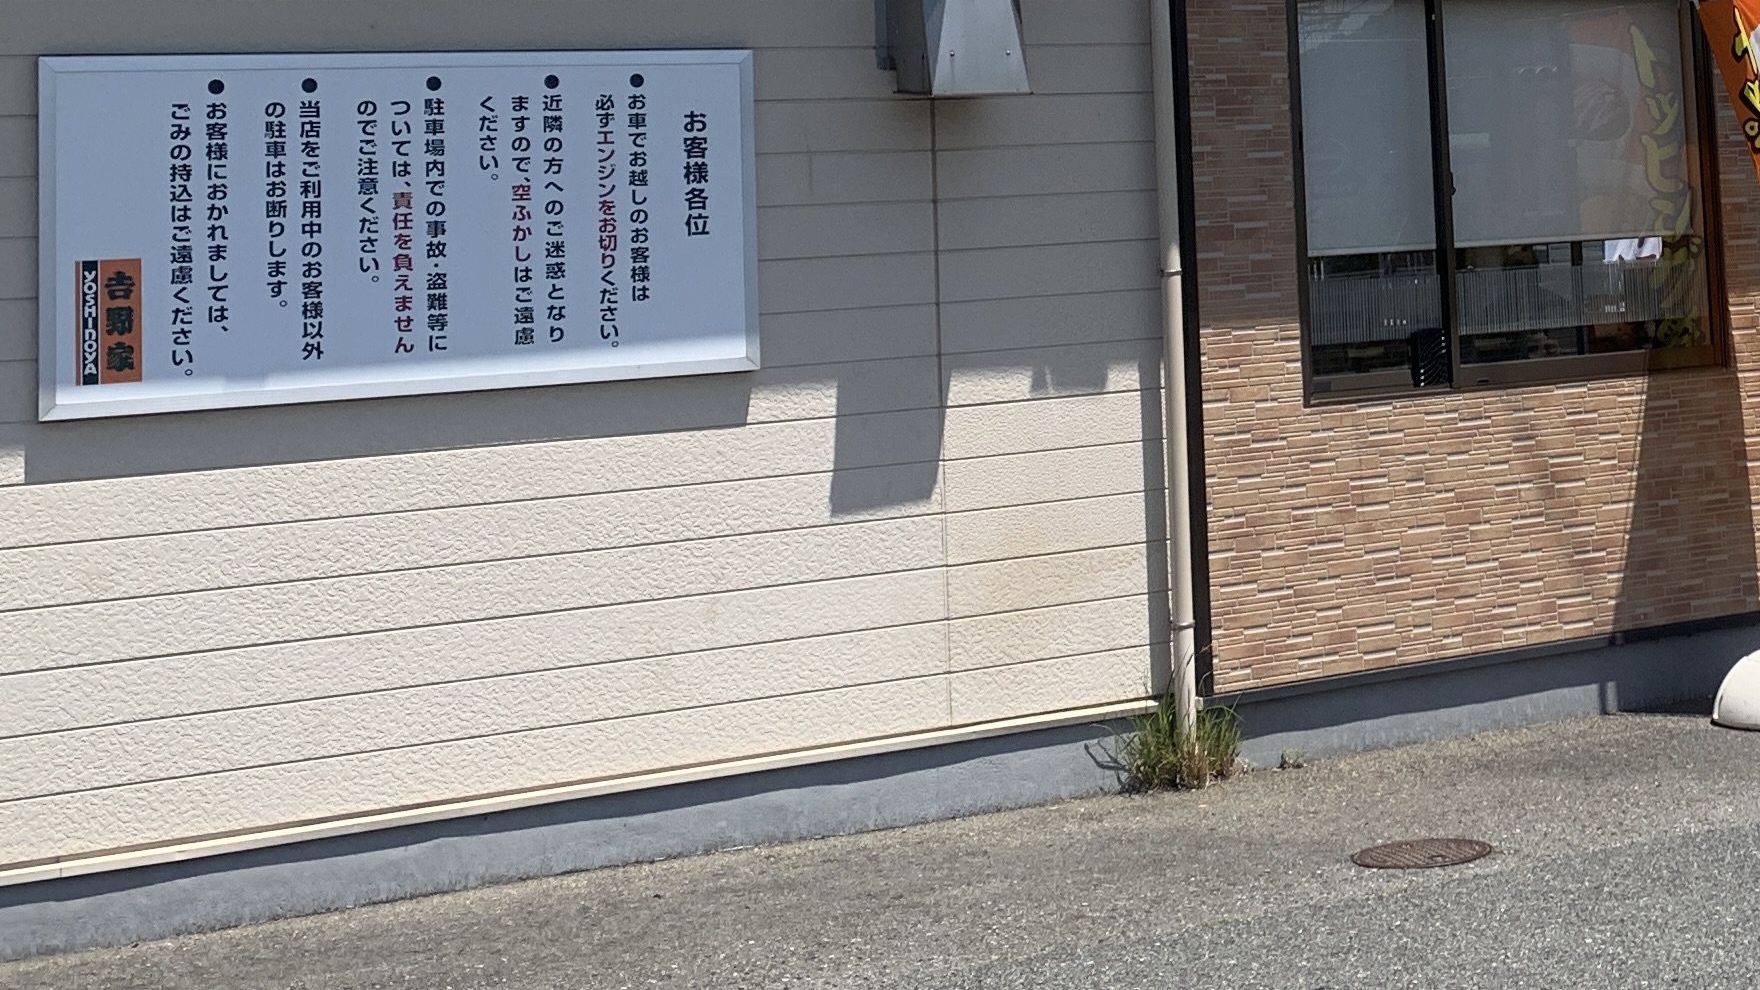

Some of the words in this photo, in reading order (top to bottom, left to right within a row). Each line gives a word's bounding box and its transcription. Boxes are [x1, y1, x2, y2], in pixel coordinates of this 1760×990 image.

[169, 103, 194, 377] ごみの持込はご遠慮ください。
[205, 102, 230, 333] お客様におかれましては、
[264, 101, 288, 308] の駐車はお断りします。
[298, 99, 325, 361] 当店をご利用中のお客様以外
[356, 100, 381, 283] のでご注意ください。
[390, 100, 415, 354] ついては、責任を負えません
[478, 95, 500, 182] ください。
[510, 95, 535, 346] ますので、空ふかしはご遠慮
[542, 93, 567, 343] 近隣の方へのご迷惑となり
[594, 93, 620, 348] 必ずエンジンをお切りください。
[627, 93, 651, 302] お車でお越しのお客様は
[683, 110, 710, 237] お客様各位
[83, 270, 98, 375] YOSHINOYA
[104, 270, 136, 372] 吉野家
